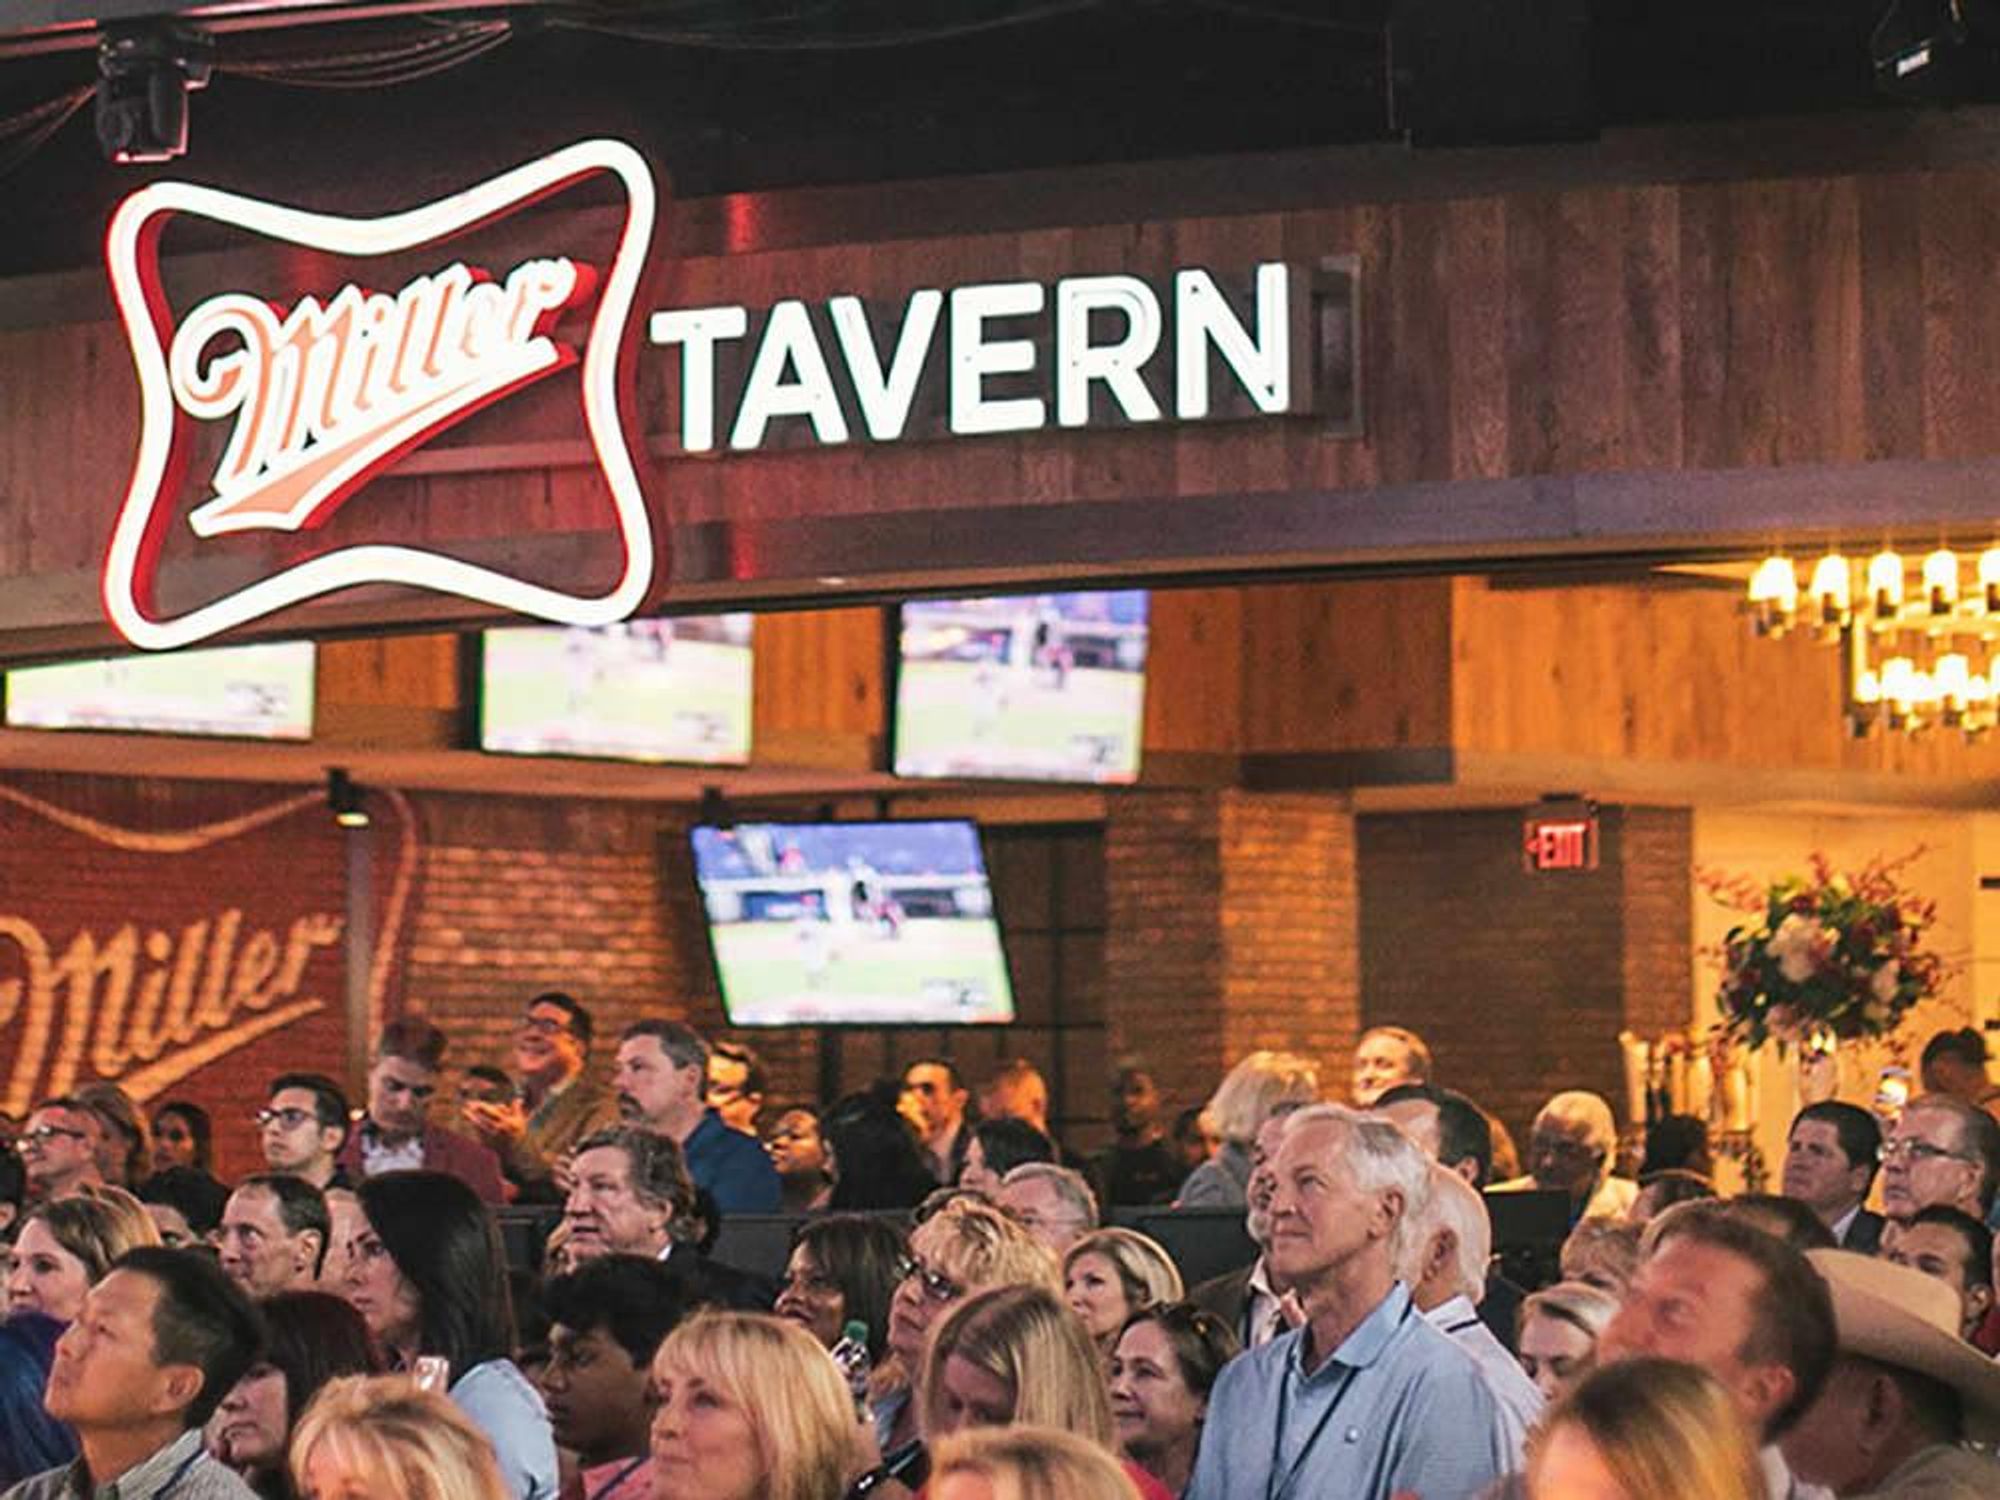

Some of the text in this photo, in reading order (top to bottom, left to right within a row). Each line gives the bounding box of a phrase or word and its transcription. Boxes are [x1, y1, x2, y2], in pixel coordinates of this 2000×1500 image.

[170, 257, 1290, 494] Miller TAVERN
[1539, 824, 1585, 868] EXIT
[0, 908, 346, 1119] Miller
